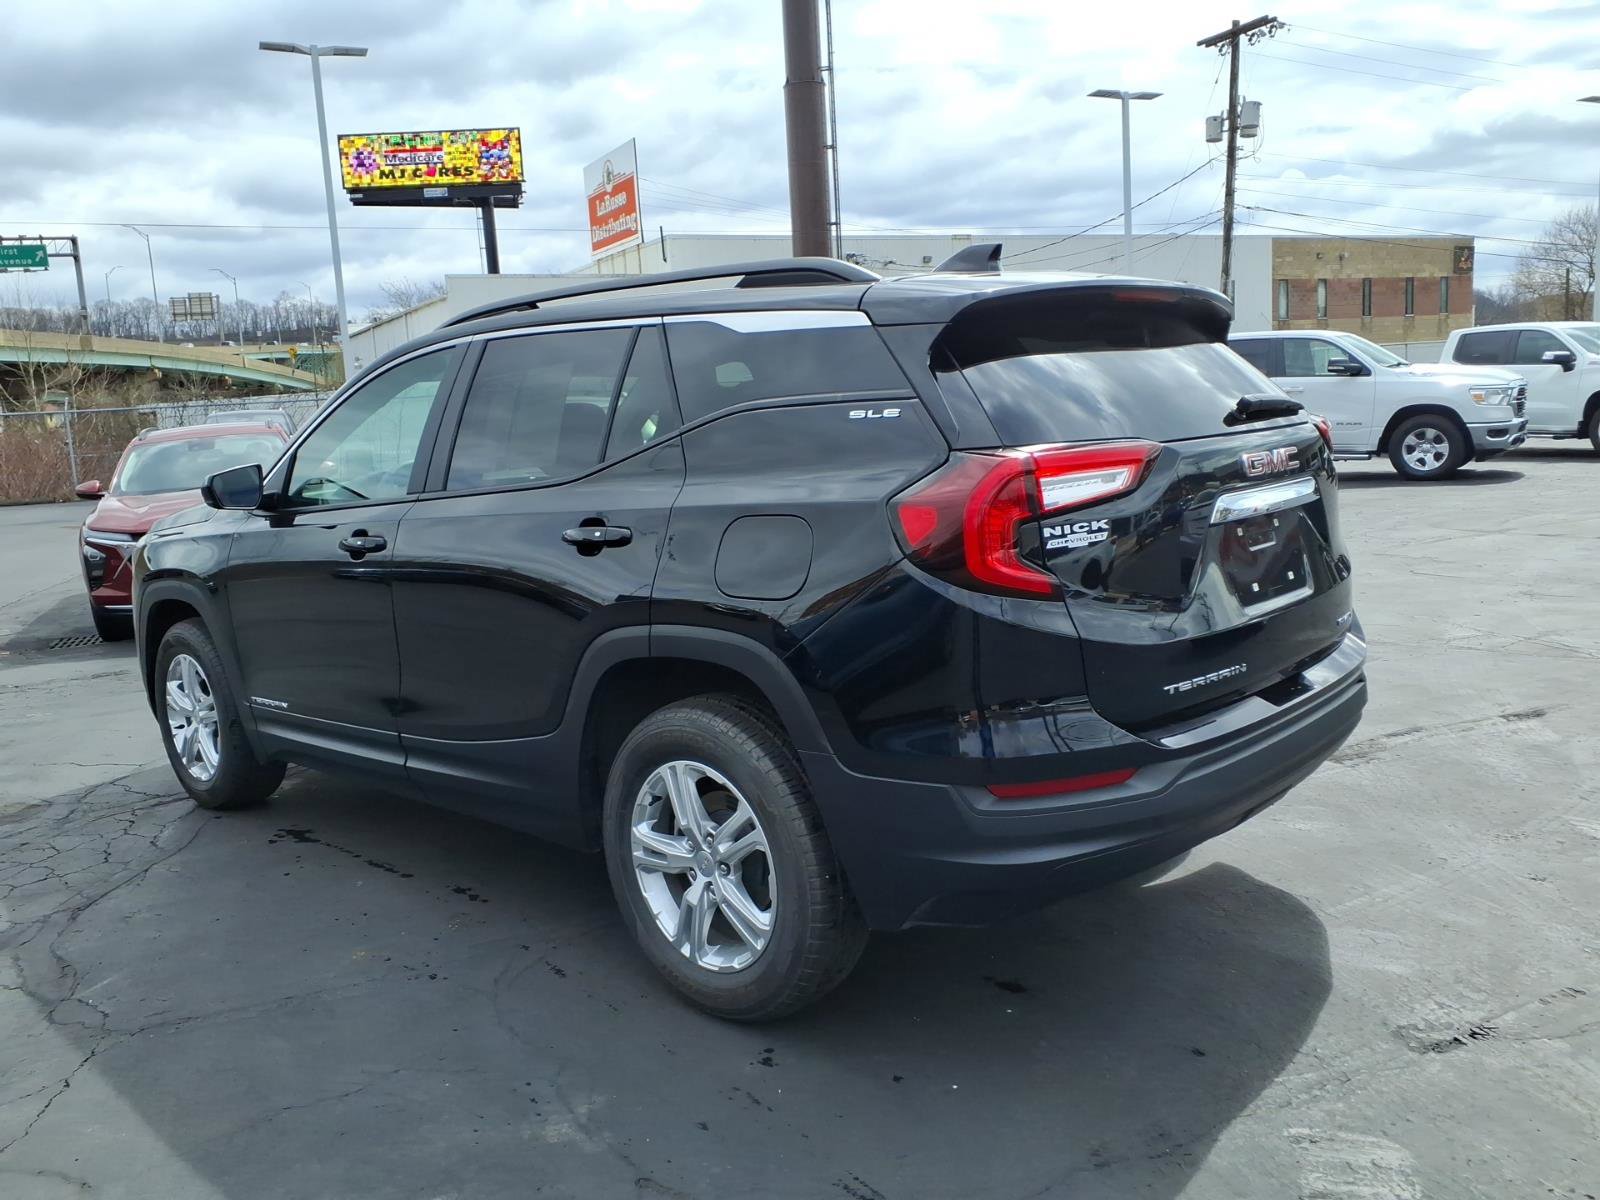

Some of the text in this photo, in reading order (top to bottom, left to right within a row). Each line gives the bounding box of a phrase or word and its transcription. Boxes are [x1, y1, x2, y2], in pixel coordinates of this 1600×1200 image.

[385, 153, 444, 163] Medicare
[378, 166, 475, 180] MJ CRES
[592, 213, 636, 243] Distributing
[849, 408, 901, 419] SLE
[1242, 446, 1300, 477] GMC
[1043, 519, 1110, 538] NICK
[1050, 533, 1106, 547] CHEVROLET
[1163, 663, 1247, 694] TERRAIN
